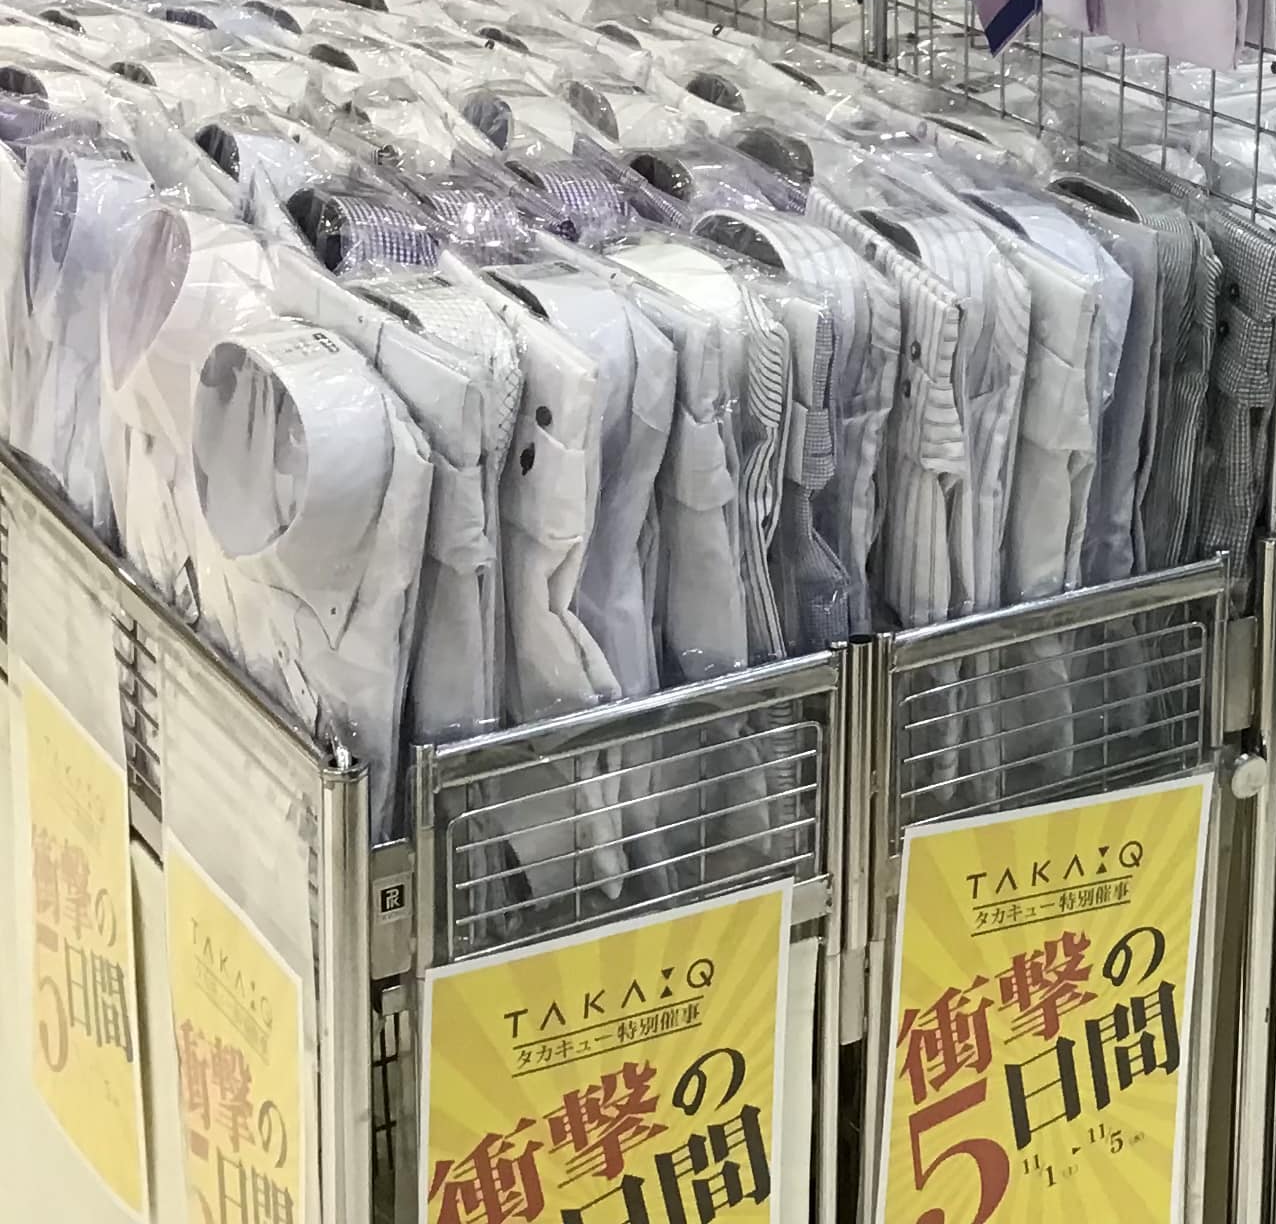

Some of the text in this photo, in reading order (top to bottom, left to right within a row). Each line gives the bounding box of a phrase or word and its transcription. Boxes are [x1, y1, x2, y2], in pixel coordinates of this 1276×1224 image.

[897, 926, 1166, 1105] 衝撃の
[908, 981, 1180, 1224] 5日間
[428, 1048, 746, 1224] 衝撃の
